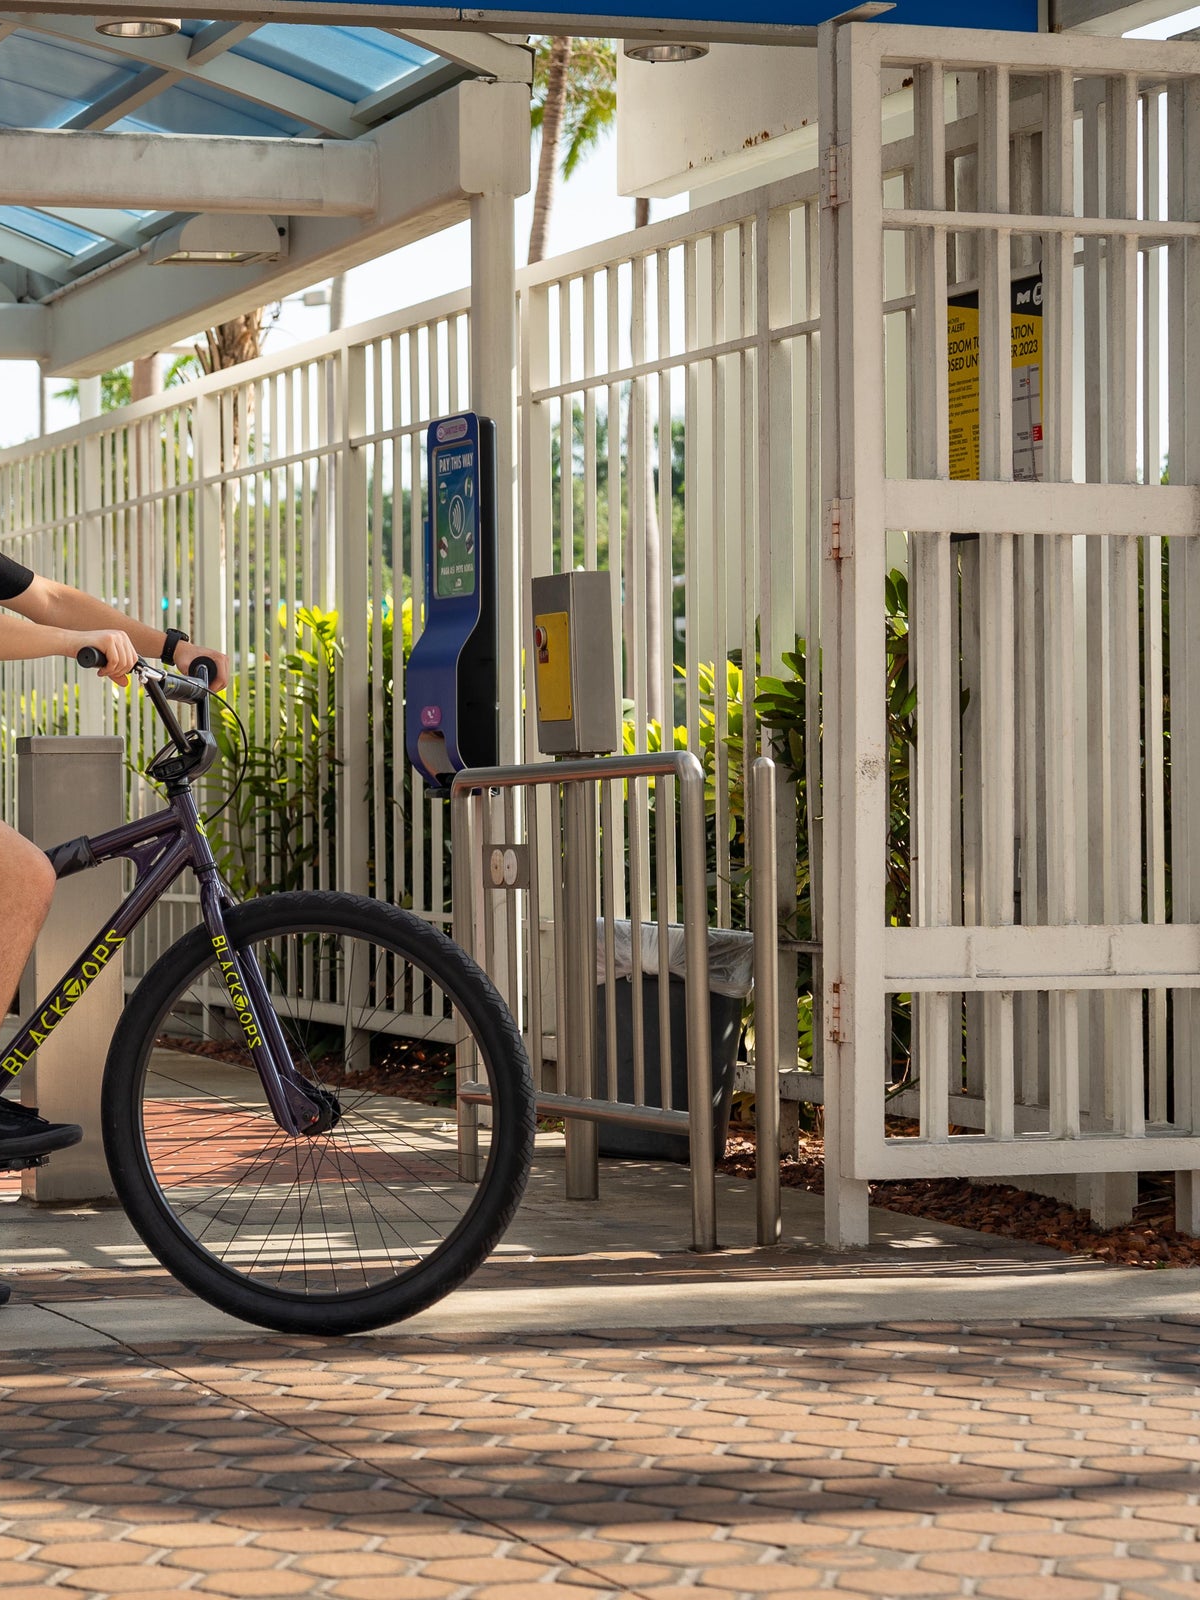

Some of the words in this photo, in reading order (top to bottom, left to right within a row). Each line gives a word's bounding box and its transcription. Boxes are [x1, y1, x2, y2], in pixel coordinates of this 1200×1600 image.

[948, 338, 971, 356] EDOM
[1011, 322, 1034, 340] ATION
[951, 322, 965, 334] ALERT
[1019, 339, 1038, 356] 2023
[439, 457, 450, 473] PAY
[451, 455, 462, 470] THIS
[462, 452, 474, 468] WAY
[2, 997, 72, 1076] BLACK
[81, 929, 127, 979] OPS
[212, 935, 243, 995] BLACK
[240, 1012, 262, 1049] OPS
